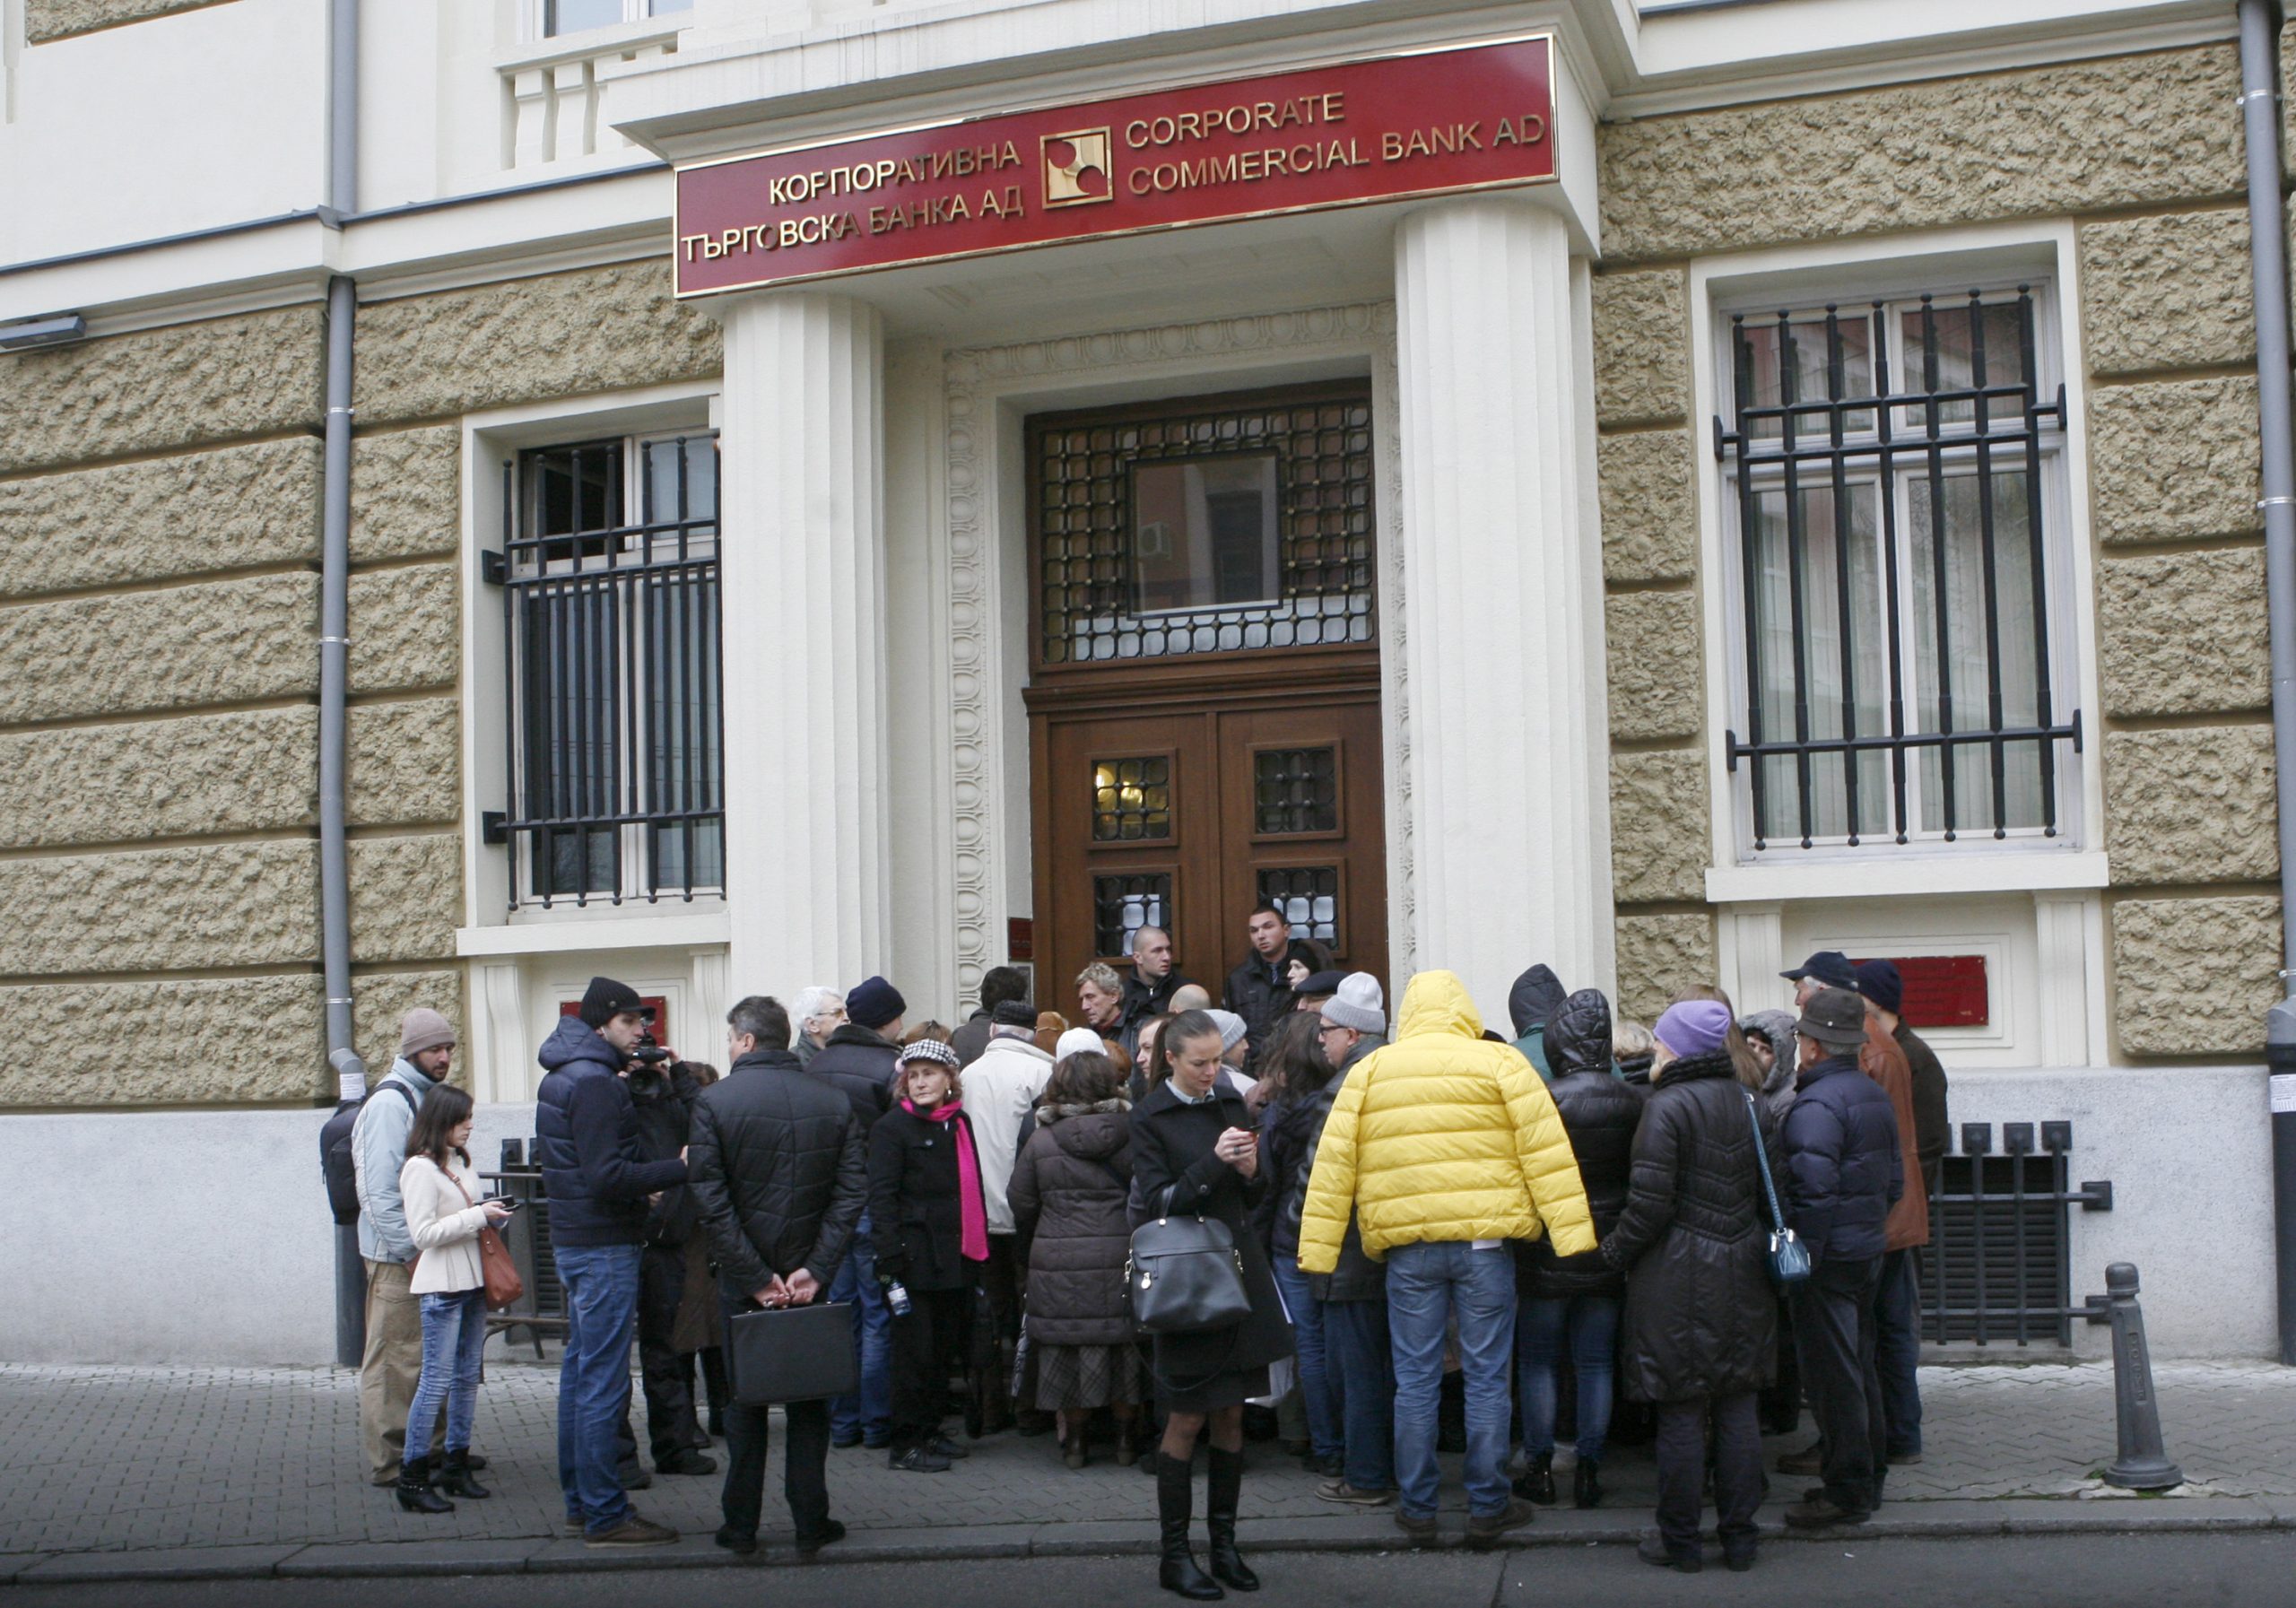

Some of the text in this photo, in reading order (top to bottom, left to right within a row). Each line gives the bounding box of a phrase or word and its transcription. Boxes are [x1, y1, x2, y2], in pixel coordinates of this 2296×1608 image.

[1125, 91, 1345, 149] CORPORATE
[1127, 114, 1546, 196] COMMERCIAL BANK AD
[770, 140, 1022, 205] КОРПОРАТИВНА
[681, 185, 1024, 262] ТЪРГОВСКА БАНКА АД
